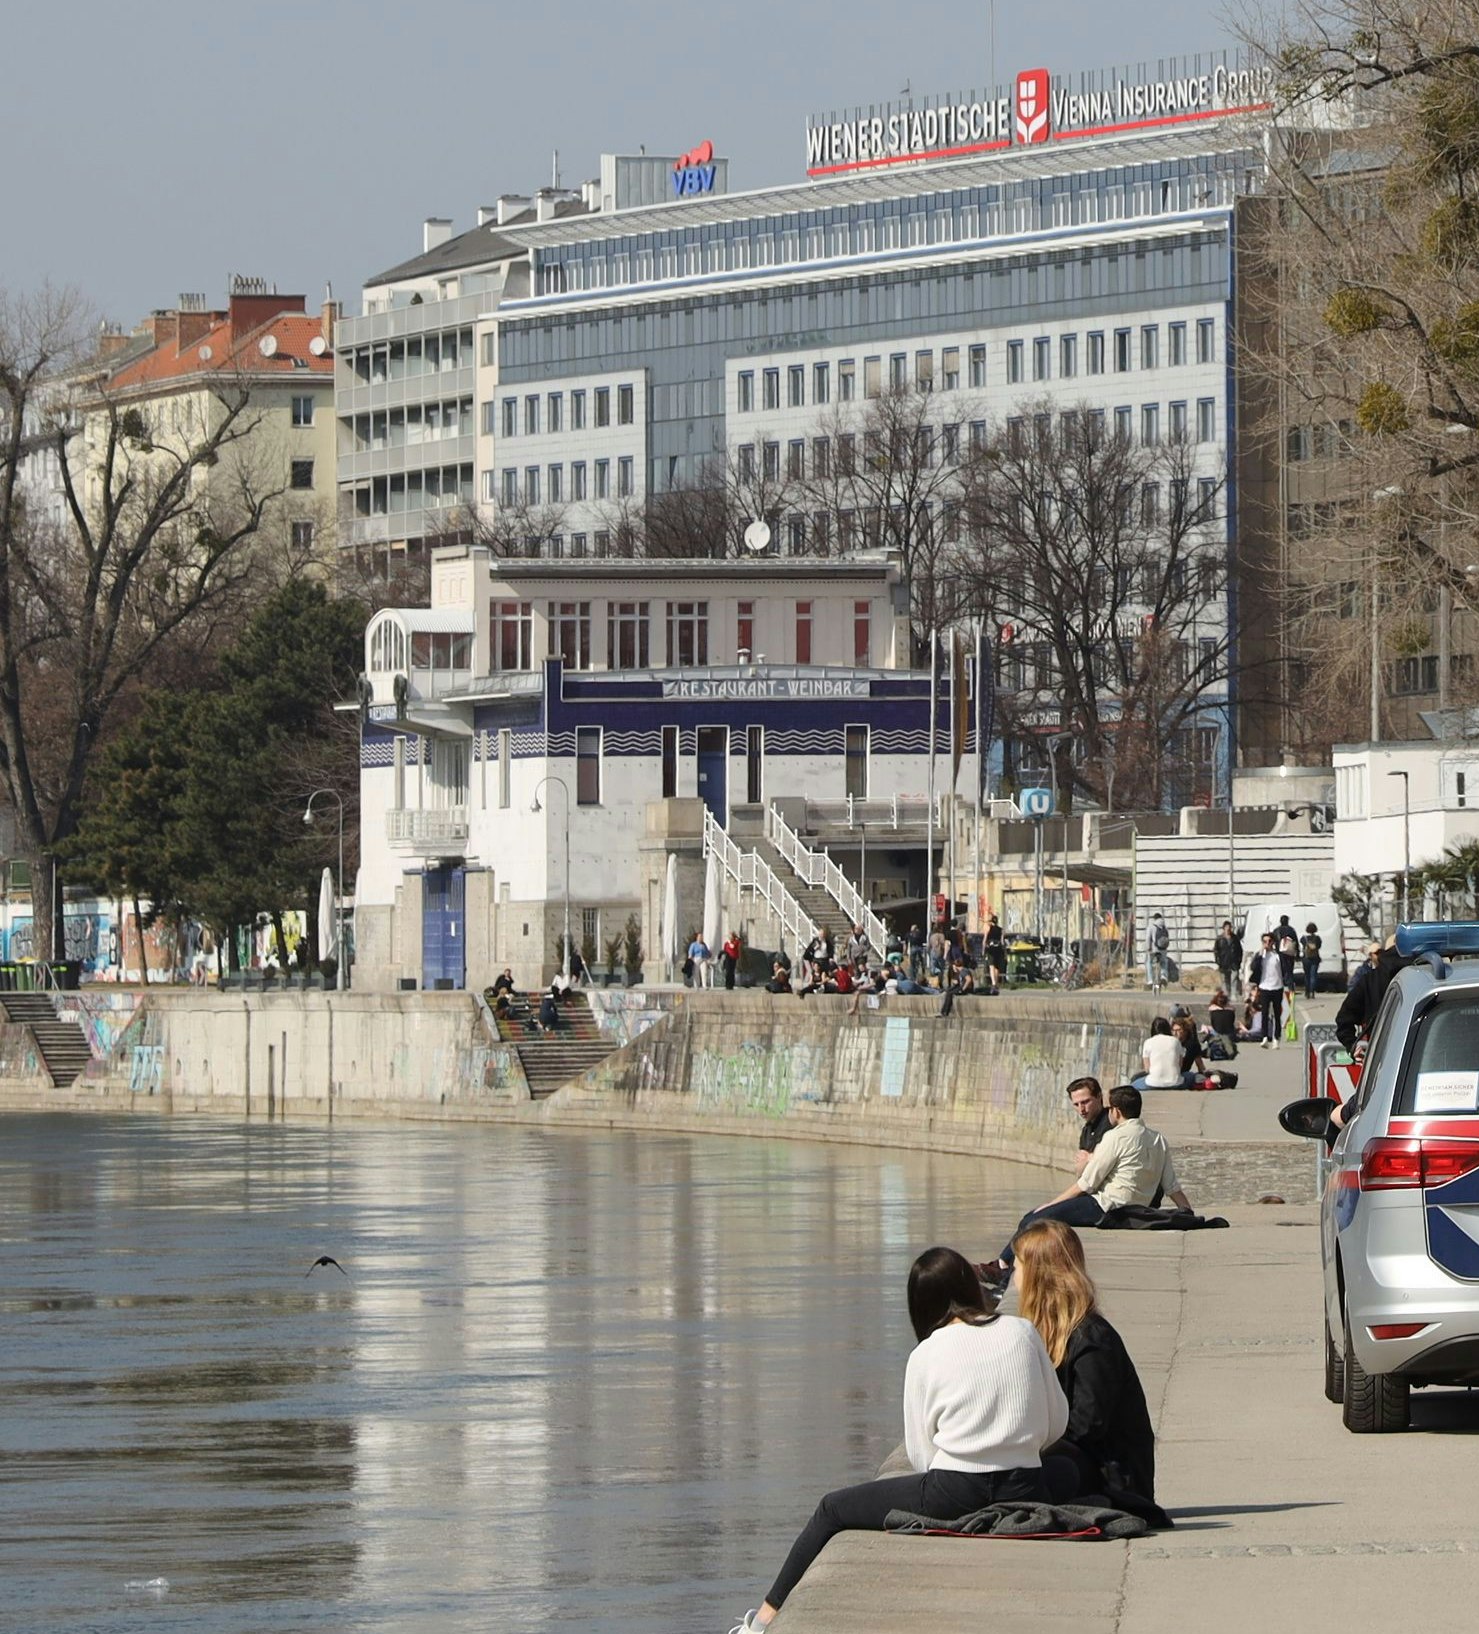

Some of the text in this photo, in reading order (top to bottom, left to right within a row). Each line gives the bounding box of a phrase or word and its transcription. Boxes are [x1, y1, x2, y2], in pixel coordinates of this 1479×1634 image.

[807, 117, 884, 163] WIENER
[888, 98, 1010, 153] STÄDTISCHE
[672, 166, 716, 195] VBV
[680, 680, 776, 697] RESTAURANT
[787, 680, 851, 696] WEINBAR
[1031, 794, 1050, 814] U
